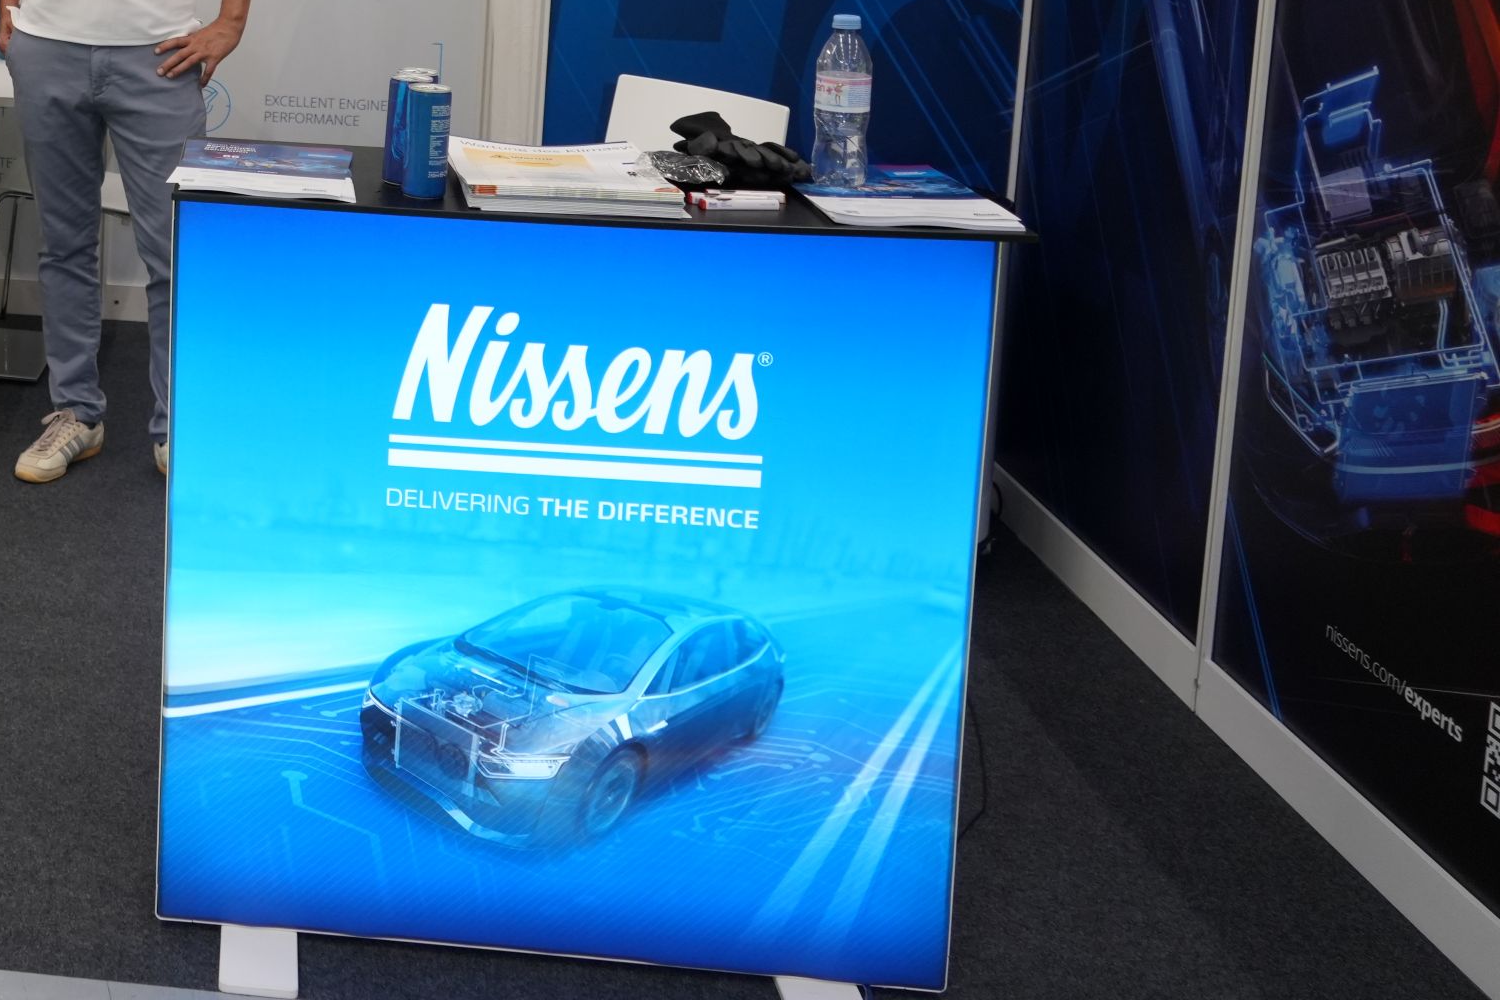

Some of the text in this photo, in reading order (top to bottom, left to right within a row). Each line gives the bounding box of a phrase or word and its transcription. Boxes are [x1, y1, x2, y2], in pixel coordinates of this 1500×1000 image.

[264, 94, 388, 112] EXCELLENT ENGINE
[264, 111, 360, 127] PERFORMANCE
[386, 488, 759, 530] DELIVERING THE DIFFERENCE
[1326, 623, 1462, 743] nissens.com/experts
